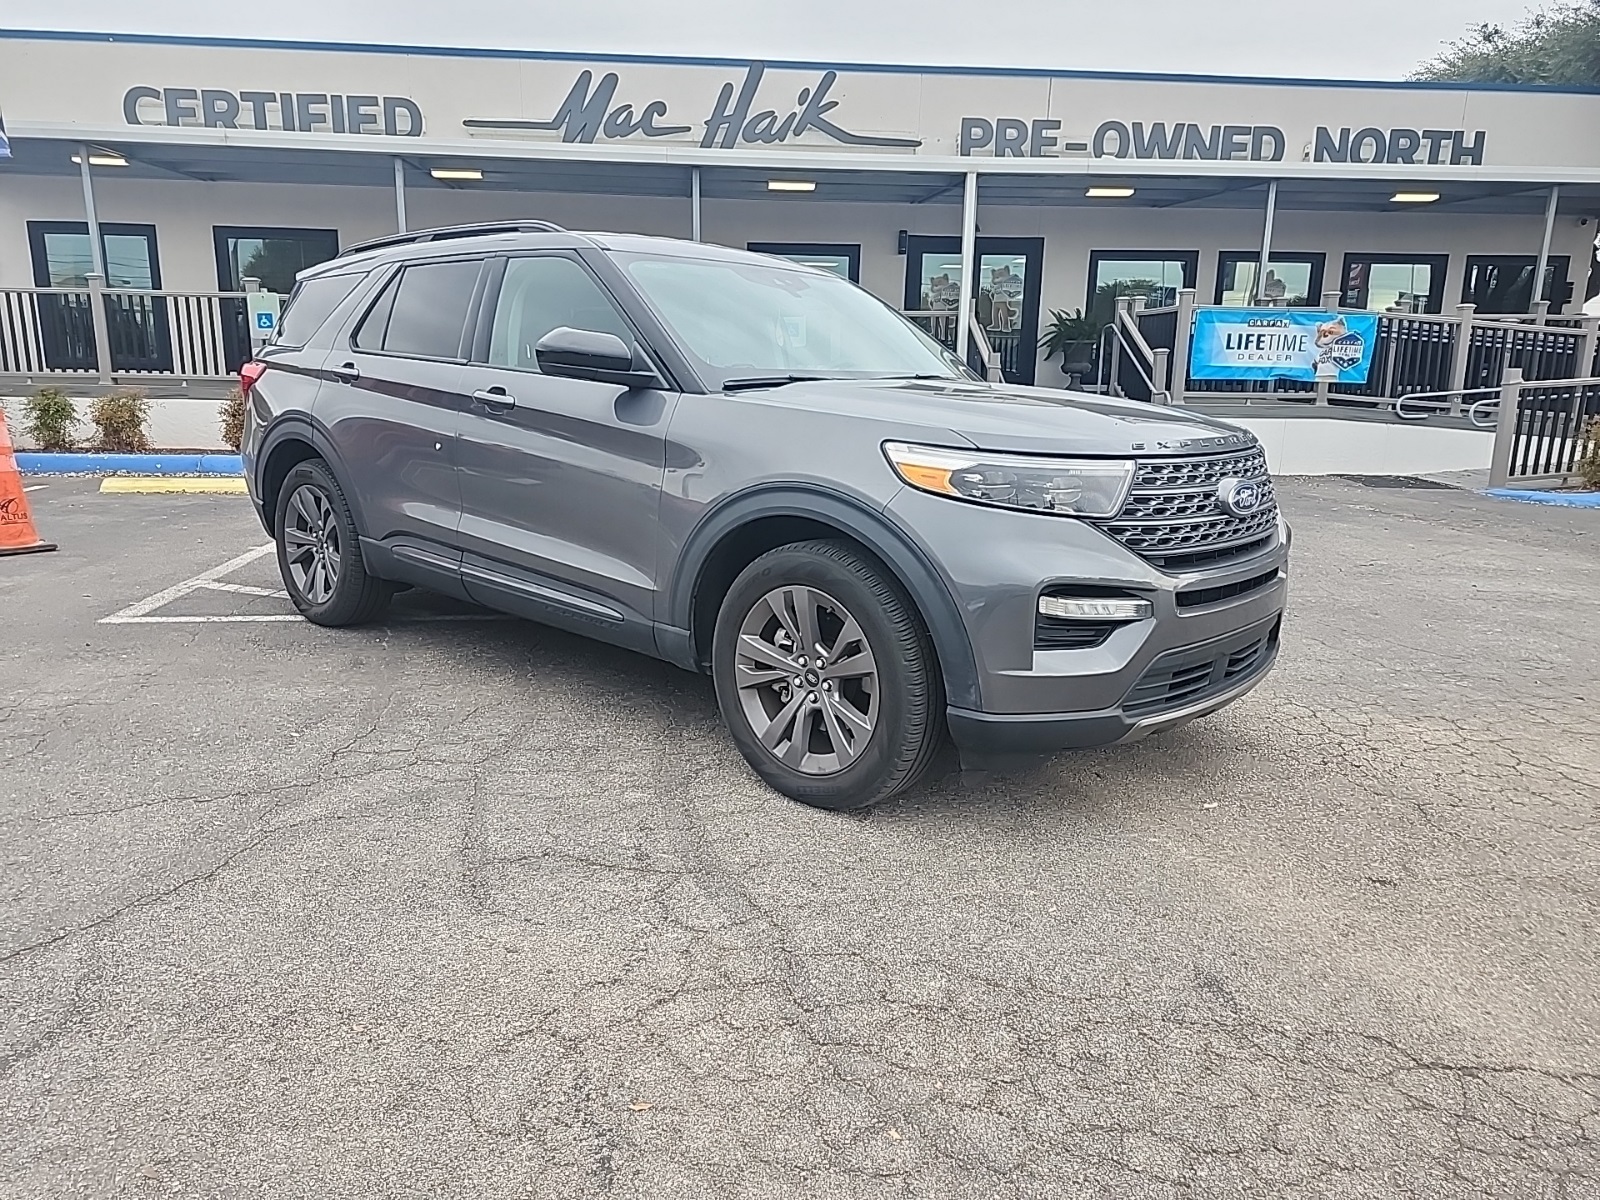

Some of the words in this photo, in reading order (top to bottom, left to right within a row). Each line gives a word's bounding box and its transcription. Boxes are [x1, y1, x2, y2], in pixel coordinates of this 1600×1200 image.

[122, 85, 424, 138] CERTIFIED
[463, 69, 692, 144] Mac
[699, 60, 923, 149] Haik
[959, 116, 1286, 162] PRE-OWNED
[1314, 126, 1486, 166] NORTH
[1248, 319, 1290, 328] CARFAX
[1226, 333, 1308, 352] LIFETIME
[1237, 353, 1292, 361] DEALER
[1233, 488, 1258, 508] Ford
[0, 512, 28, 521] ALTUS
